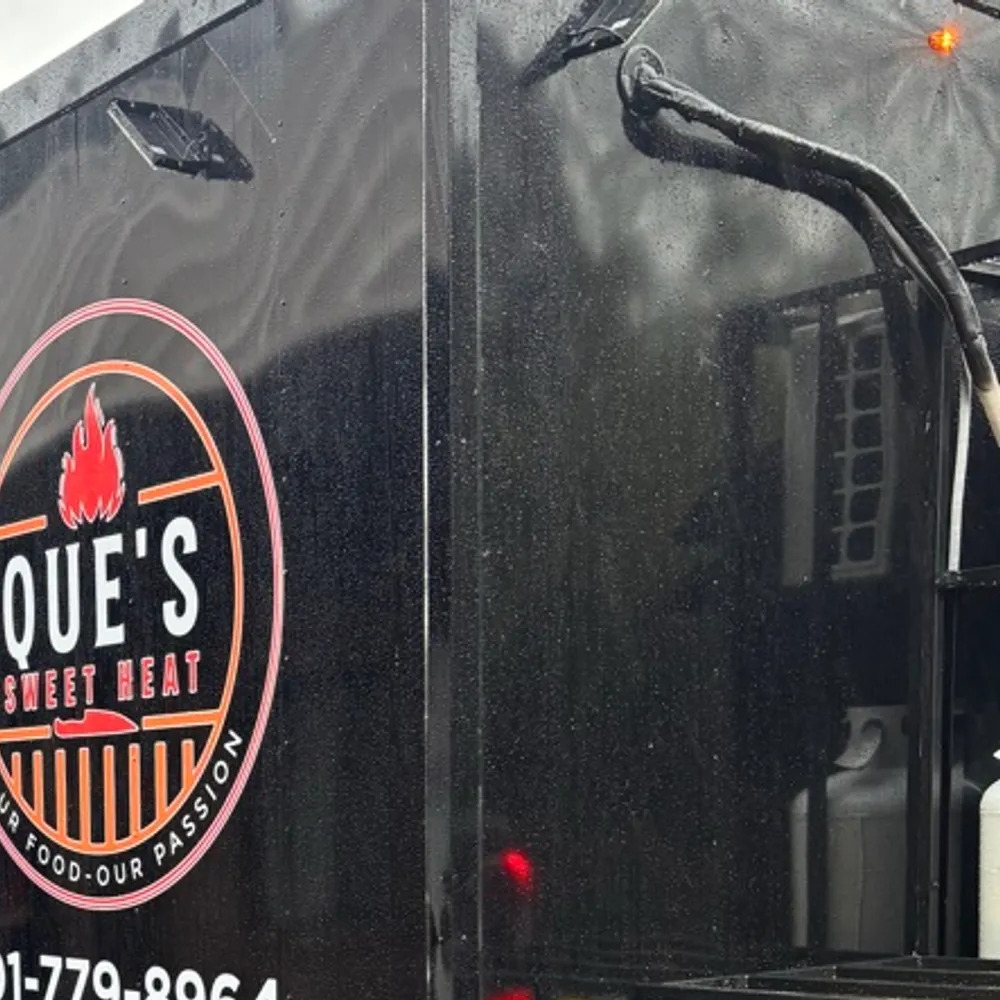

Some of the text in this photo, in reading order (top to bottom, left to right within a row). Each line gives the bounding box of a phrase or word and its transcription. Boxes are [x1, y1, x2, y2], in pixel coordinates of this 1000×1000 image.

[2, 516, 199, 670] QUE'S
[3, 650, 201, 714] SWEET HEAT
[153, 729, 244, 866] PASSION
